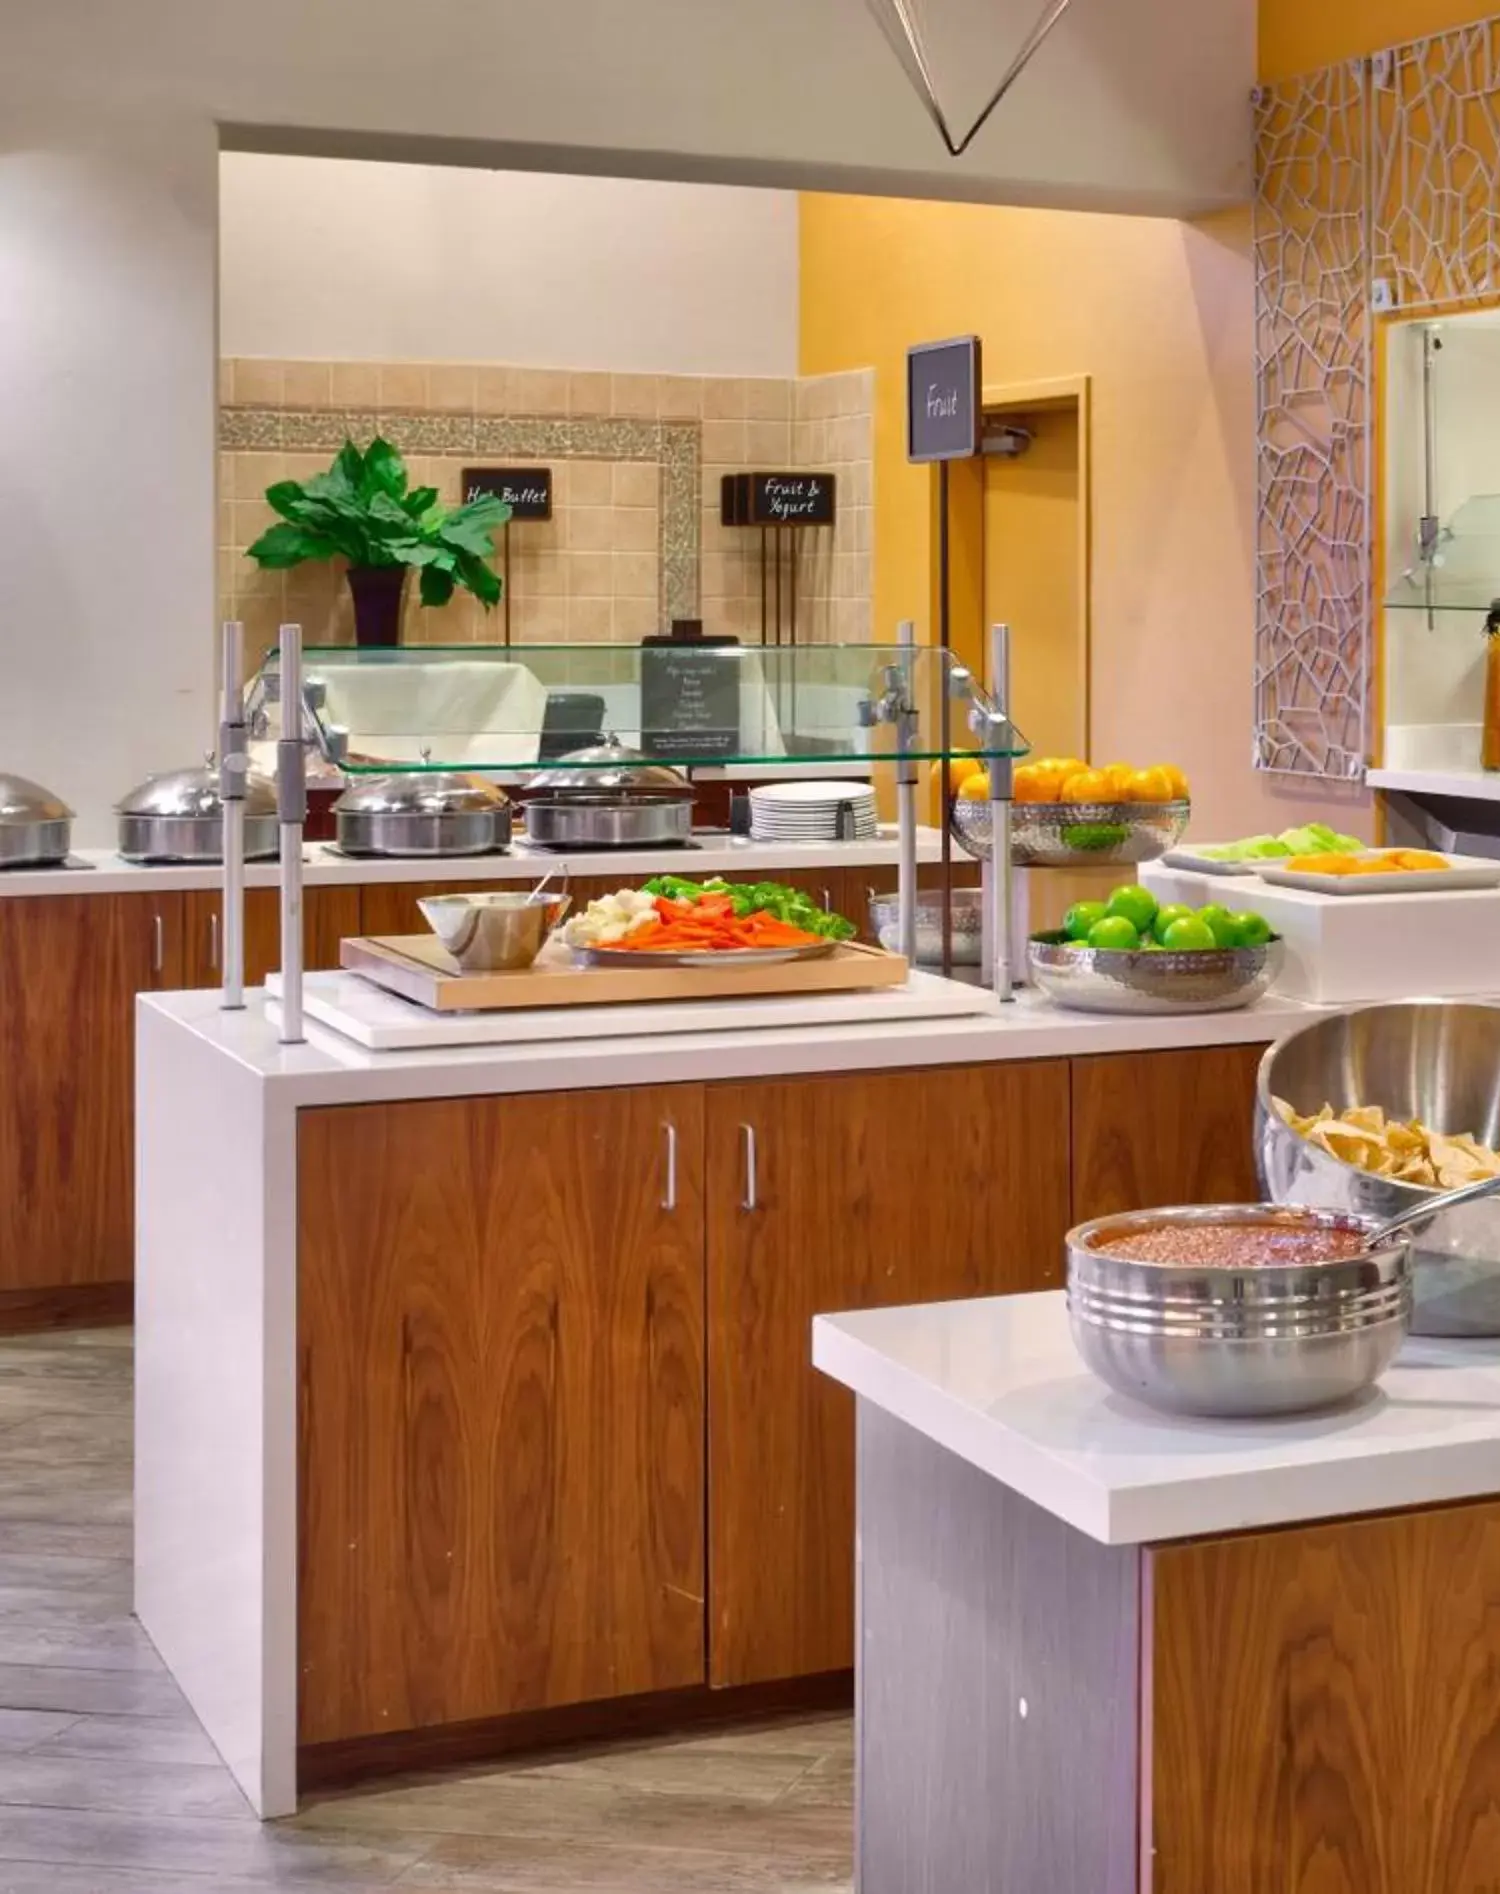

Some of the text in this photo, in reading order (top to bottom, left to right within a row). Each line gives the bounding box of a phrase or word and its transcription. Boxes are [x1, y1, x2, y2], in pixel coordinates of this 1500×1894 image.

[927, 383, 957, 418] Fruit
[502, 487, 548, 503] Buffet
[765, 477, 820, 497] Fruit &
[769, 497, 816, 521] Yogurt
